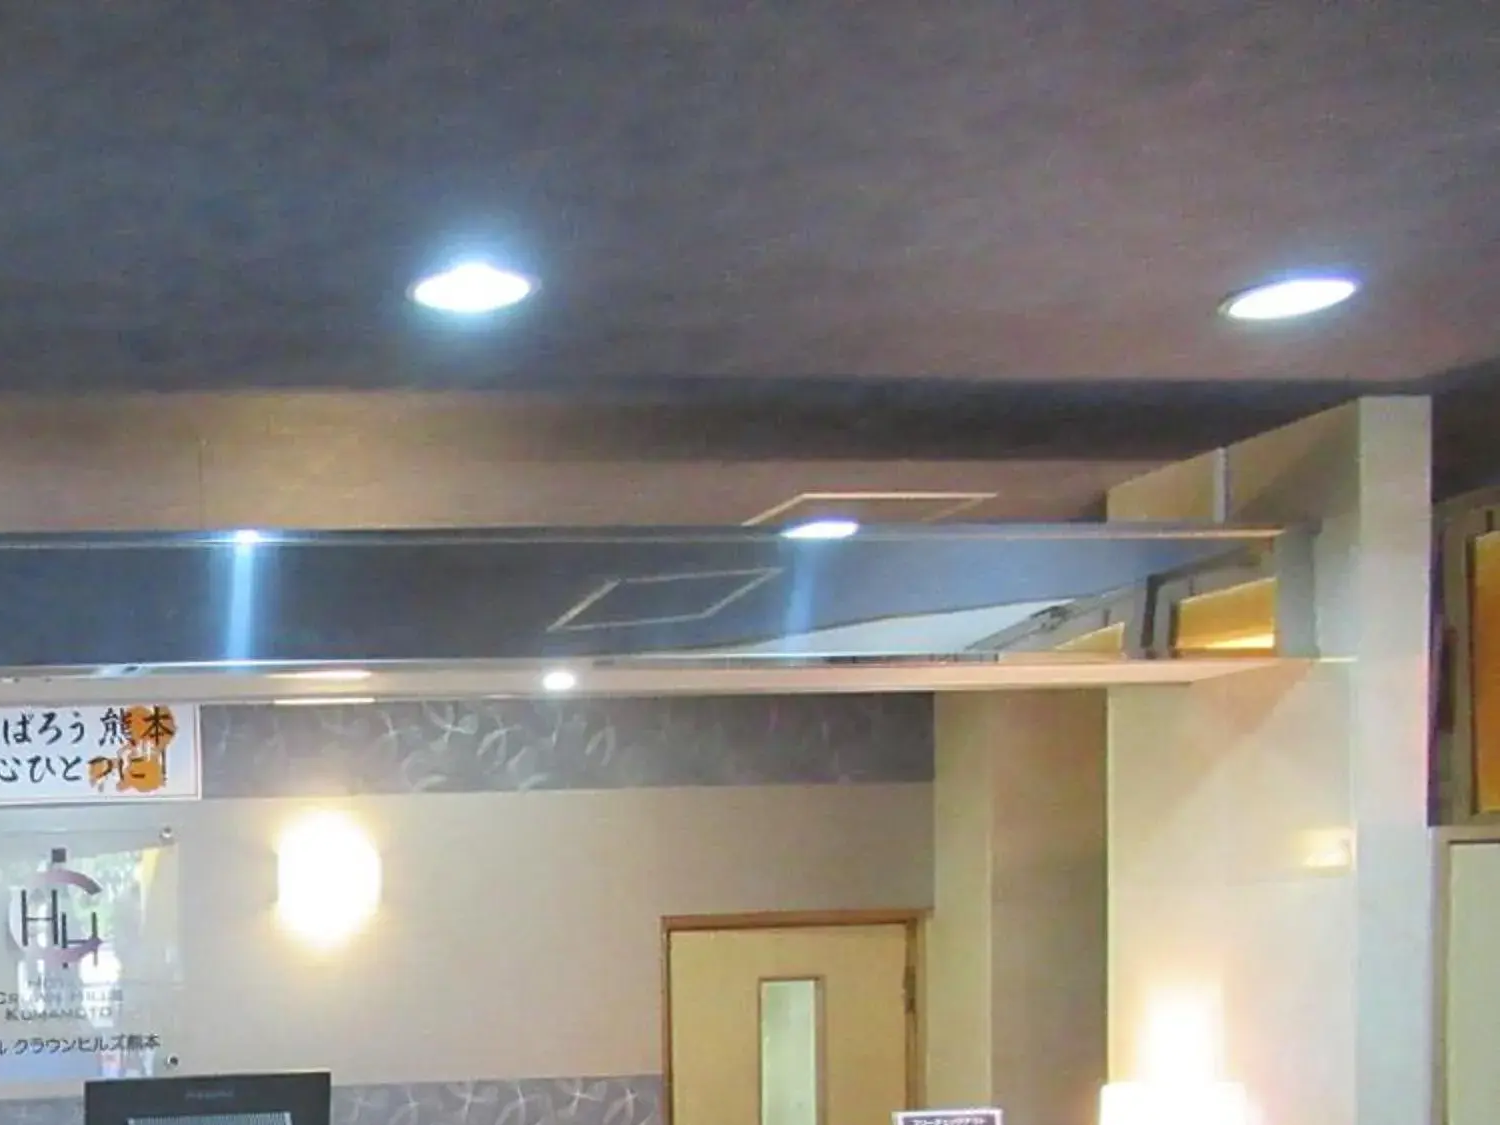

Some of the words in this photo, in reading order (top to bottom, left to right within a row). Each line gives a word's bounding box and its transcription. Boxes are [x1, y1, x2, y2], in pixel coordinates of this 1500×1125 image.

[4, 1006, 113, 1021] KUMAMOTO
[13, 1034, 161, 1055] クラウンヒルズ熊本
